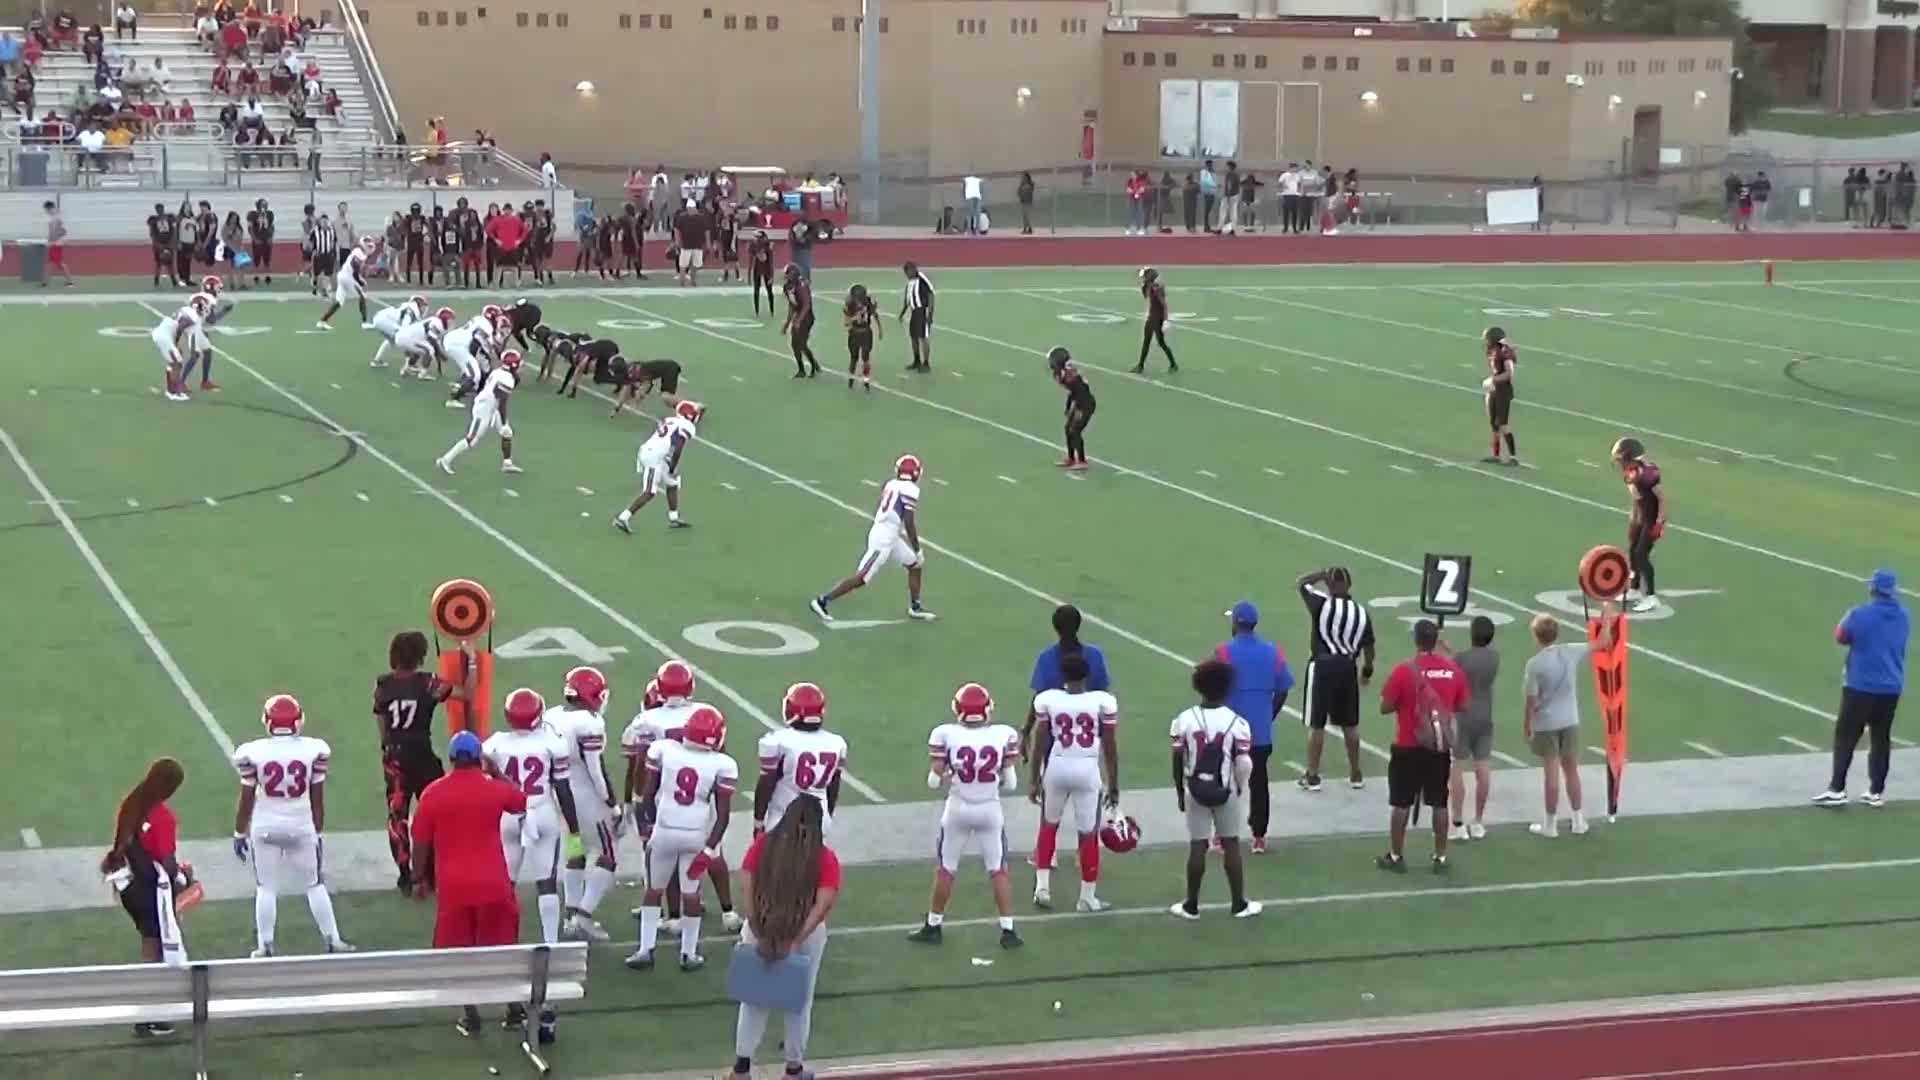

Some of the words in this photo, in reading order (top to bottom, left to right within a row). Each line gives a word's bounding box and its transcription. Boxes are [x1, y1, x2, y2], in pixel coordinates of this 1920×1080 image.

[1433, 559, 1460, 603] 2
[387, 699, 418, 729] 17
[1055, 712, 1095, 749] 33
[263, 759, 307, 798] 23
[795, 751, 837, 790] 67
[956, 745, 998, 784] 32
[673, 766, 699, 806] 9
